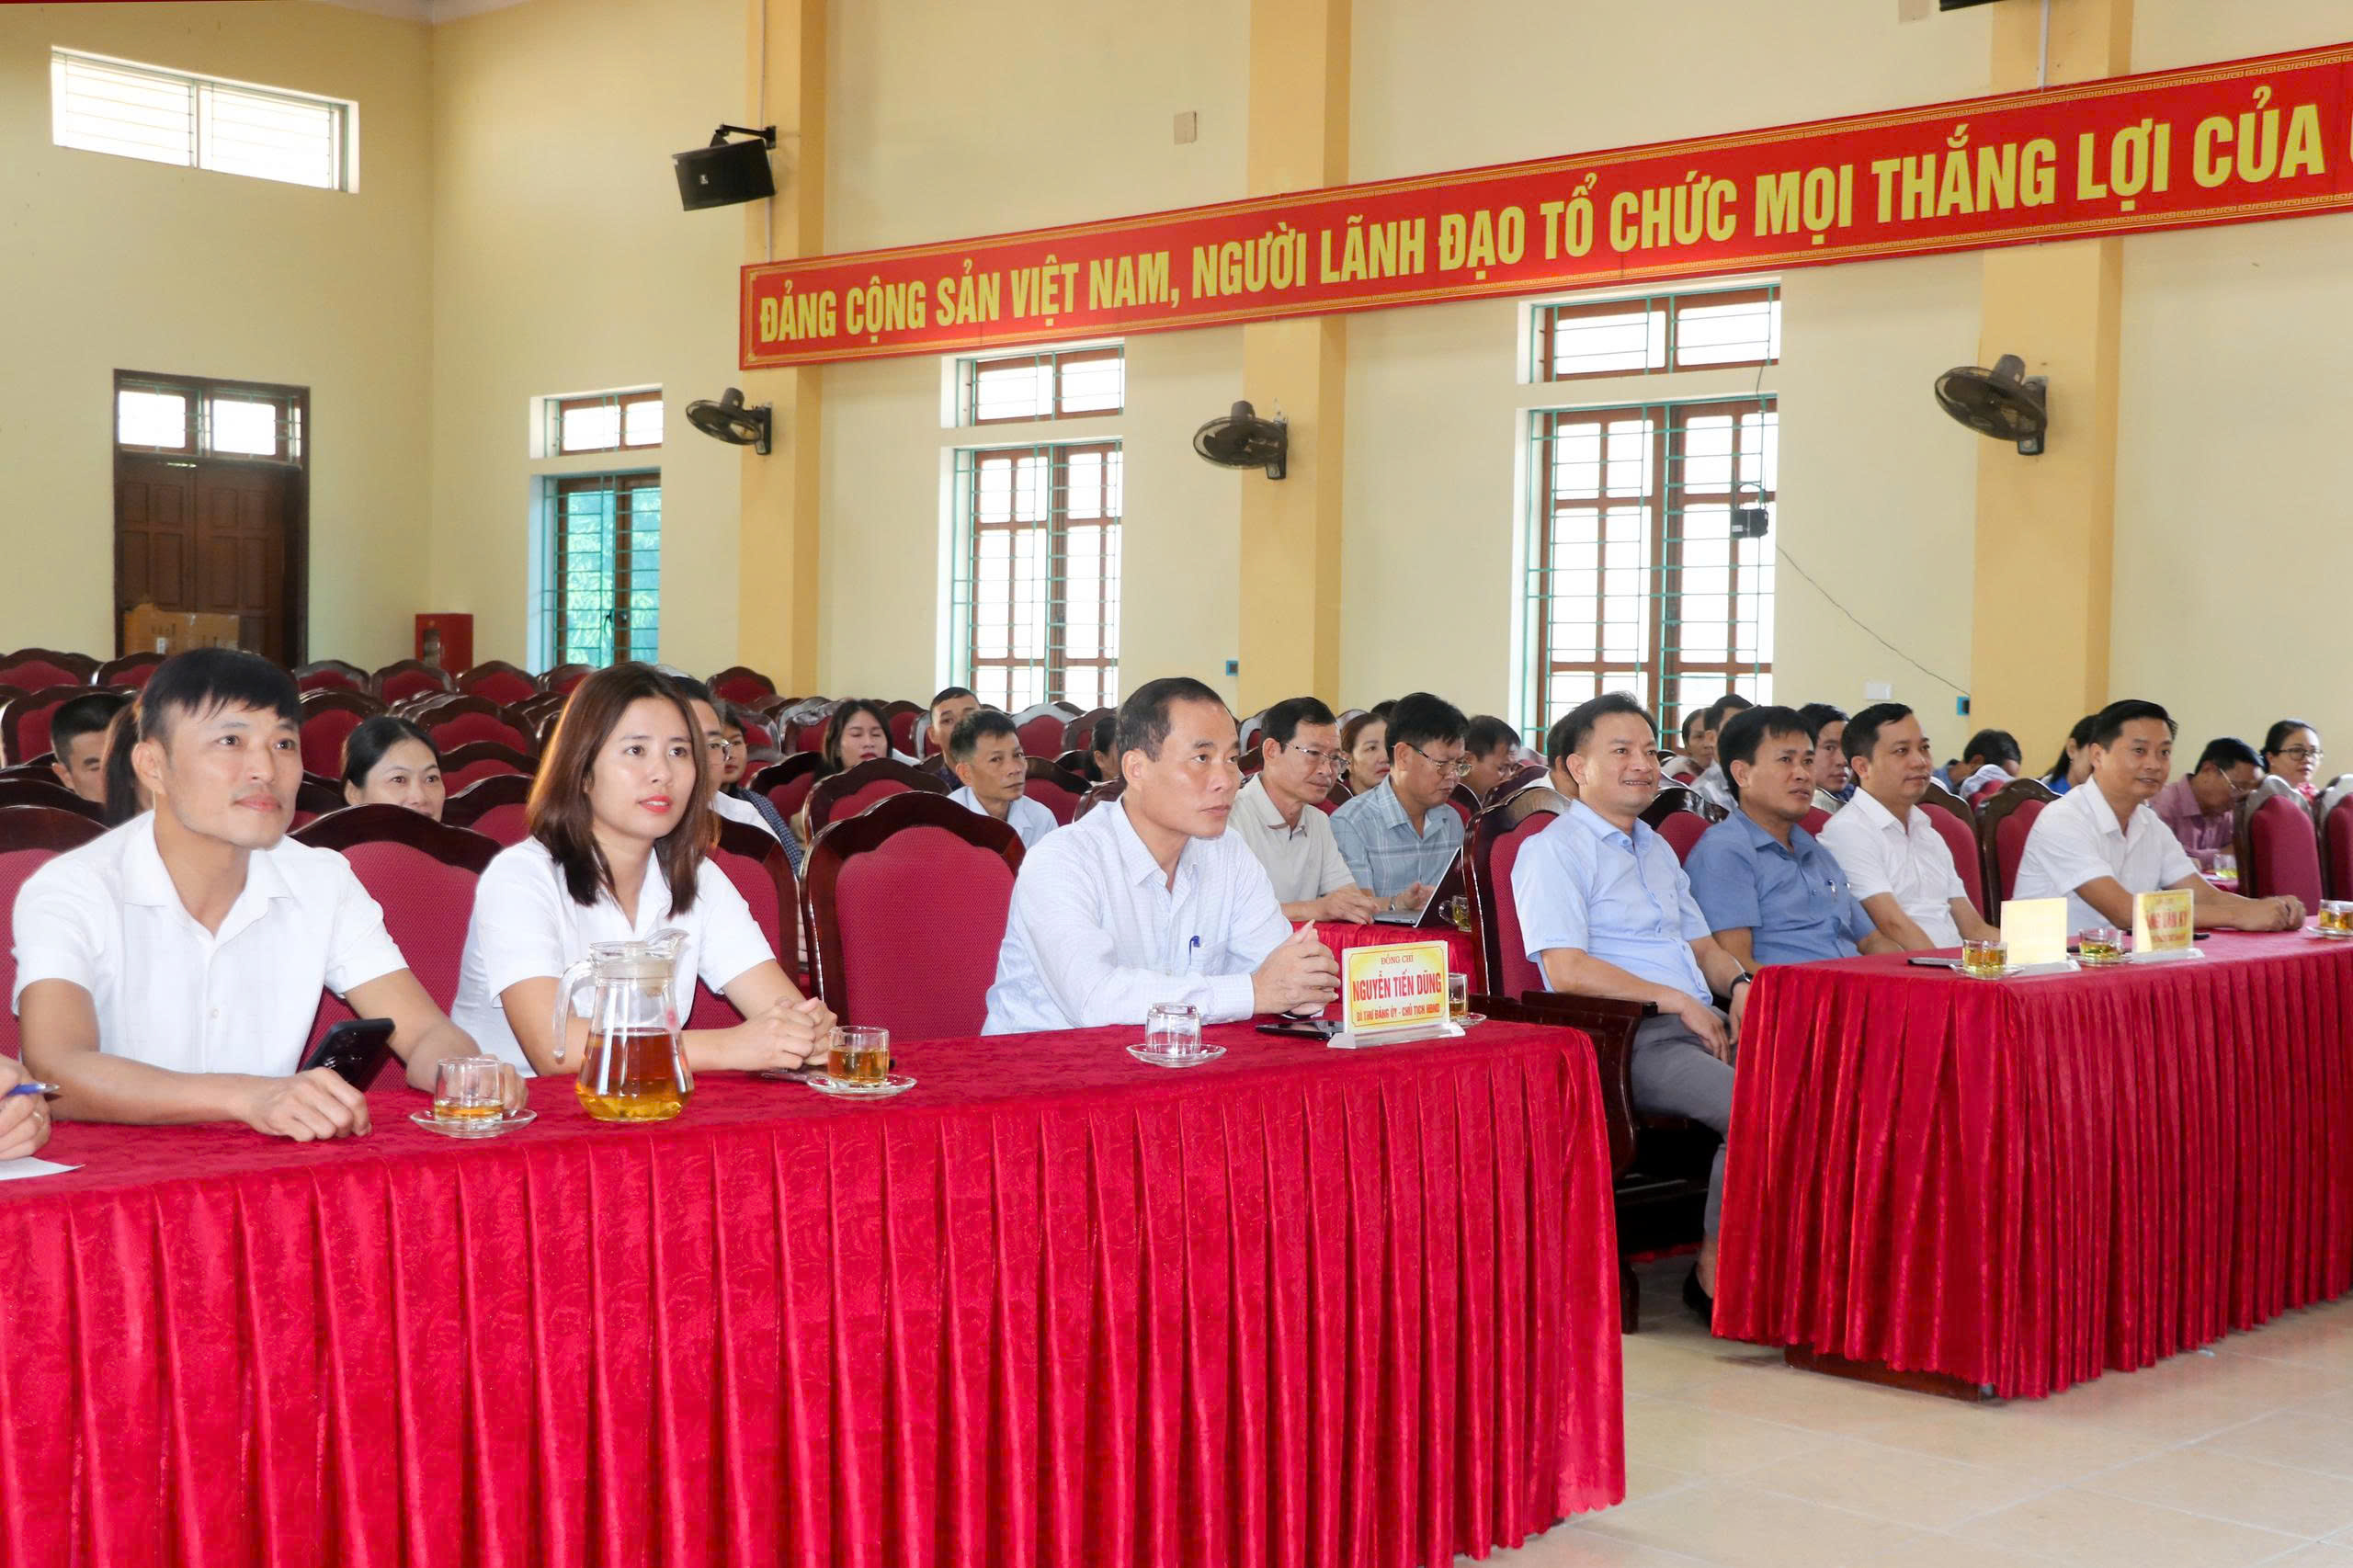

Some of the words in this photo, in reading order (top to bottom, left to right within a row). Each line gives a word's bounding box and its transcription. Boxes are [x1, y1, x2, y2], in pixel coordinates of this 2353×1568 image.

[759, 278, 836, 344] ĐẢNG
[846, 279, 926, 345] CỘNG
[936, 259, 1001, 326] SẢN
[1010, 263, 1079, 327] VIỆT
[1088, 250, 1180, 311] NAM,
[1192, 222, 1307, 297] NGƯỜI
[1321, 213, 1426, 283] LÃNH
[1438, 205, 1526, 279] ĐẠO
[1540, 172, 1598, 259] TỔ
[1608, 168, 1738, 252] CHỨC
[1754, 165, 1854, 246] MỌI
[1872, 123, 2056, 222] THẮNG
[2075, 116, 2171, 212] LỢI
[2192, 85, 2327, 186] CỦA
[1353, 971, 1391, 1002] NGUYỄN
[1393, 969, 1415, 997] TIẾN
[1417, 970, 1442, 994] DŨNG
